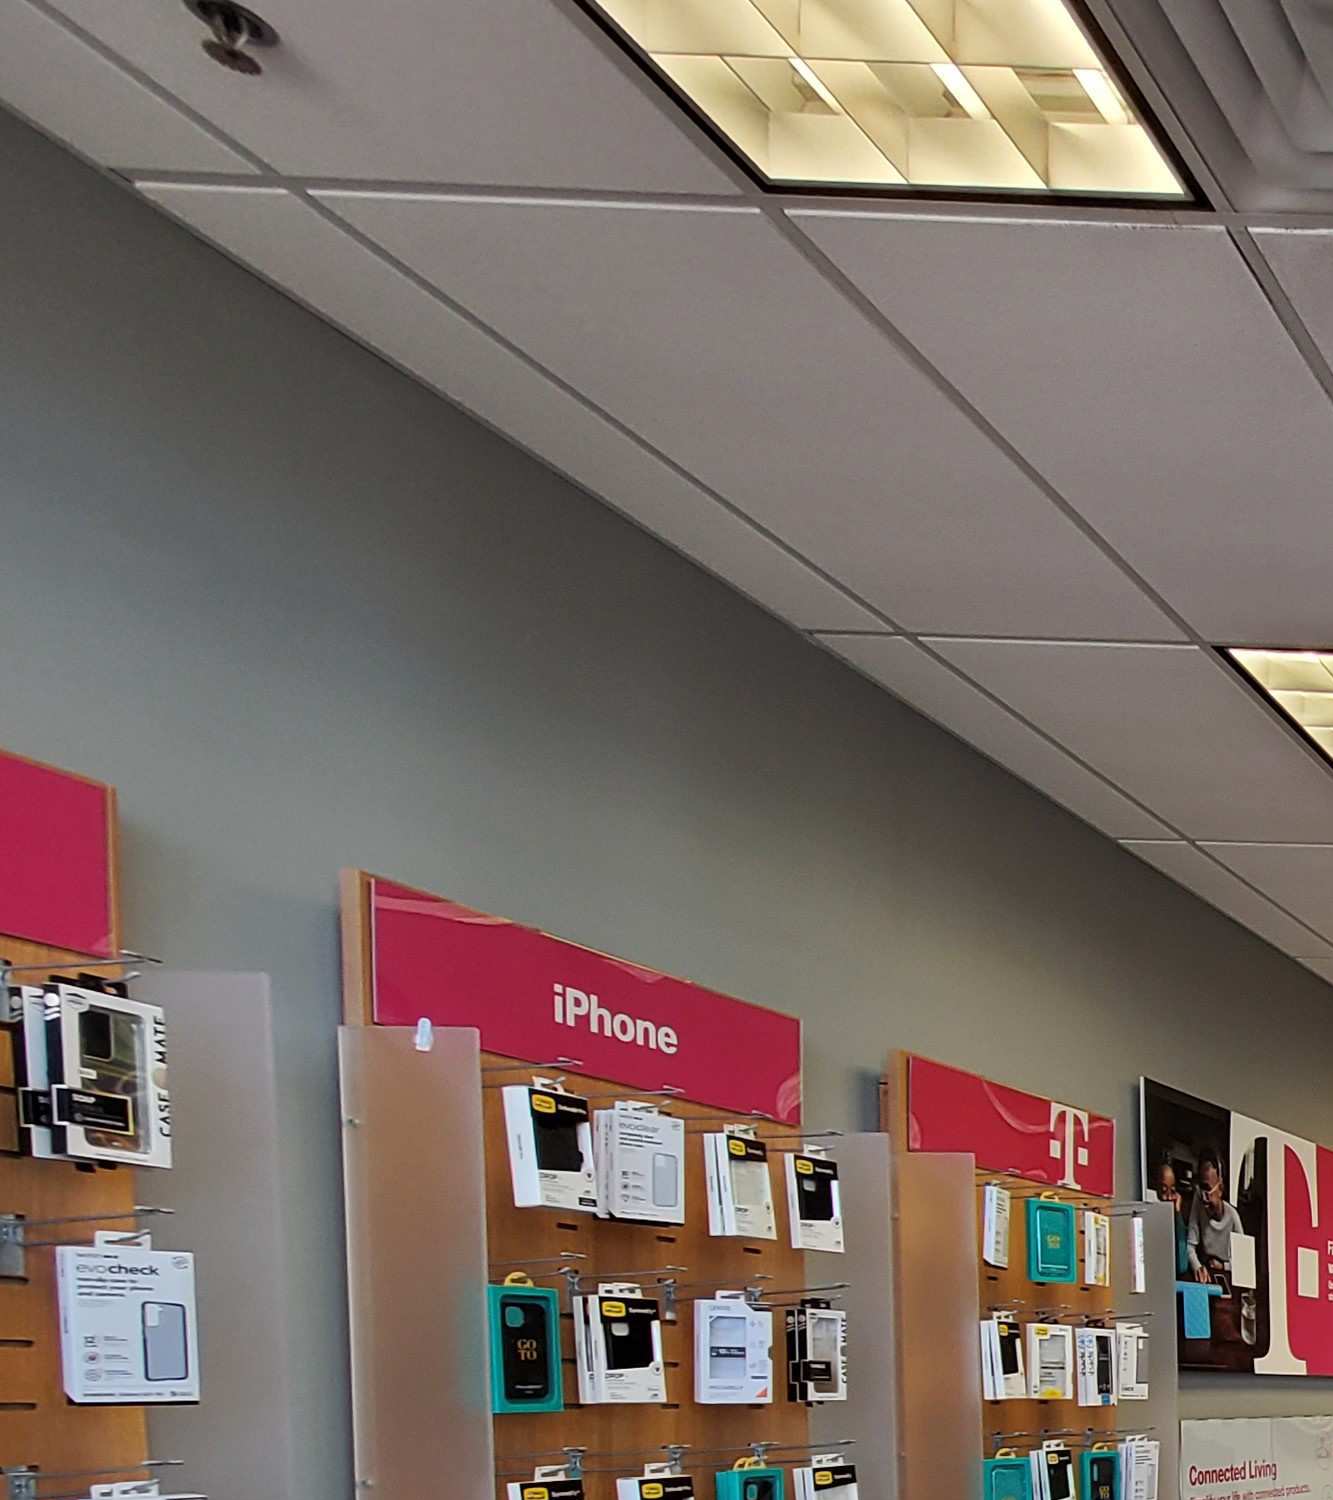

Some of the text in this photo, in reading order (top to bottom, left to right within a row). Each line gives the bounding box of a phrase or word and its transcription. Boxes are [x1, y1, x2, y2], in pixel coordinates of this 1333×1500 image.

[553, 983, 679, 1055] iPhone
[75, 1263, 160, 1277] evocheck
[516, 1338, 537, 1350] GO
[517, 1349, 537, 1361] TO
[1189, 1460, 1278, 1486] Connected Living
